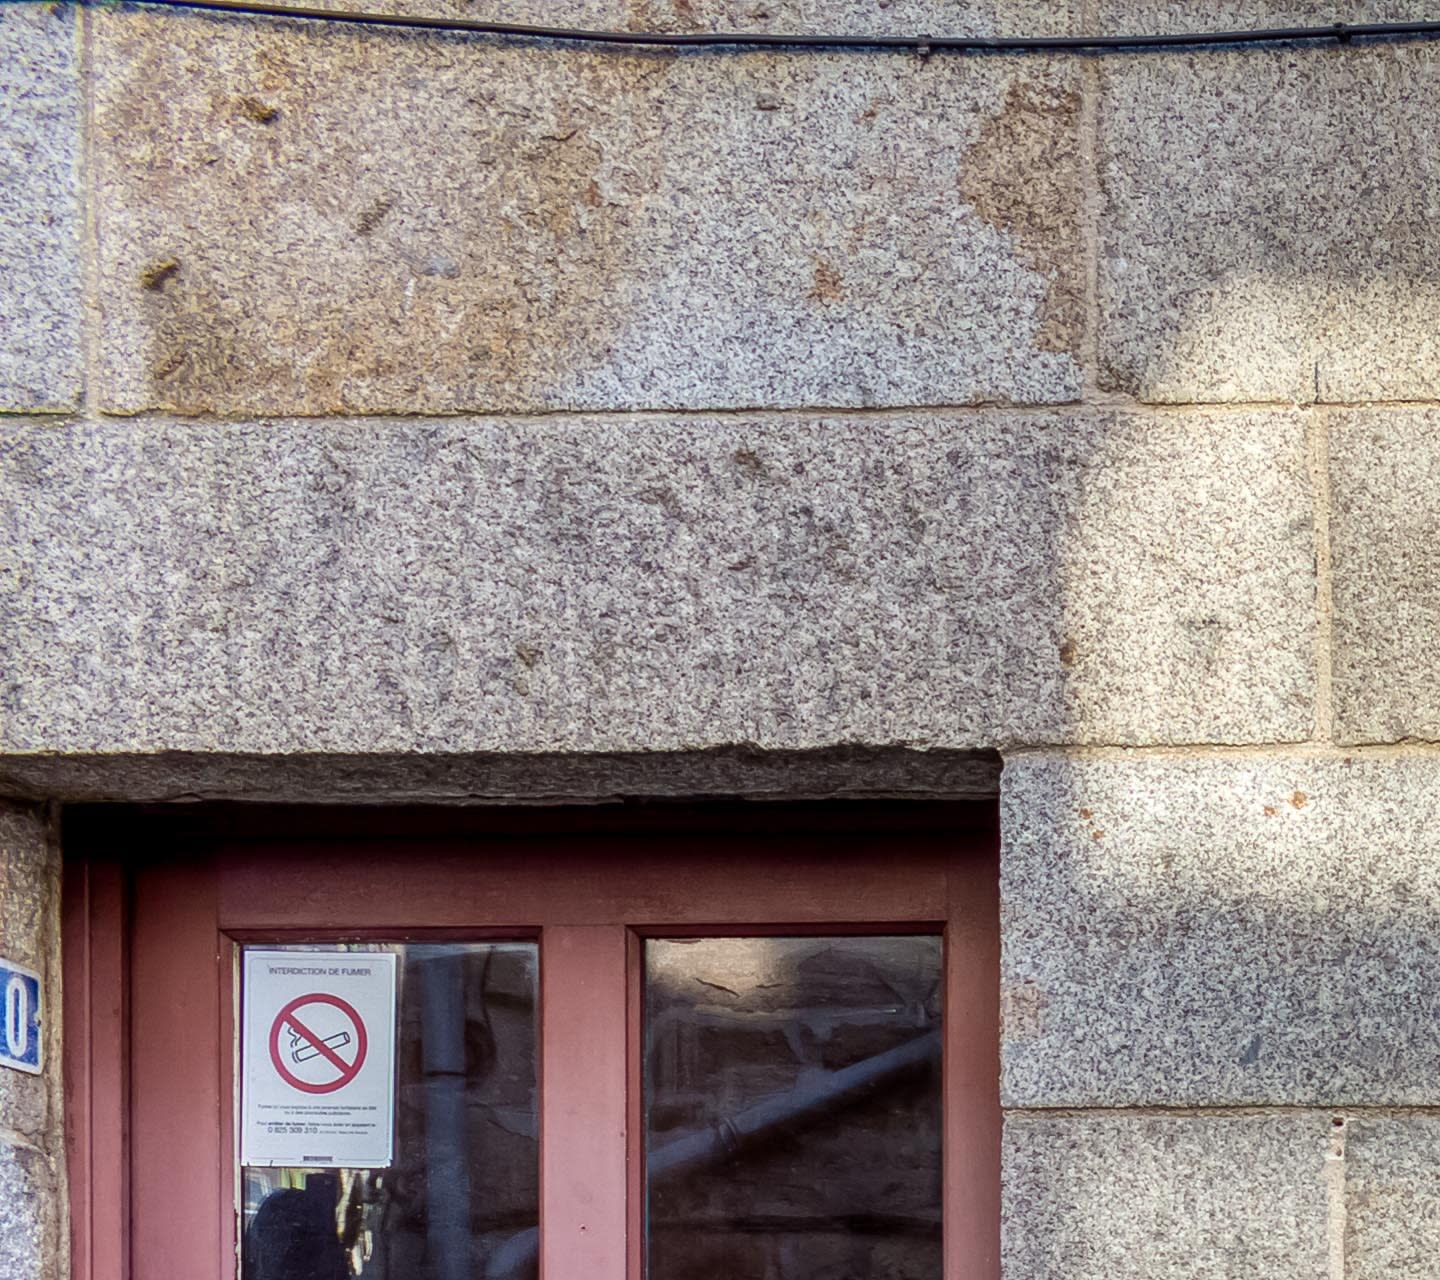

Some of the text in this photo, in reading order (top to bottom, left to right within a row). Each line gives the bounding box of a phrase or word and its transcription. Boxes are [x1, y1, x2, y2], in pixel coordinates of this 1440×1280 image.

[269, 967, 371, 977] INTERDICTION DE FUMER
